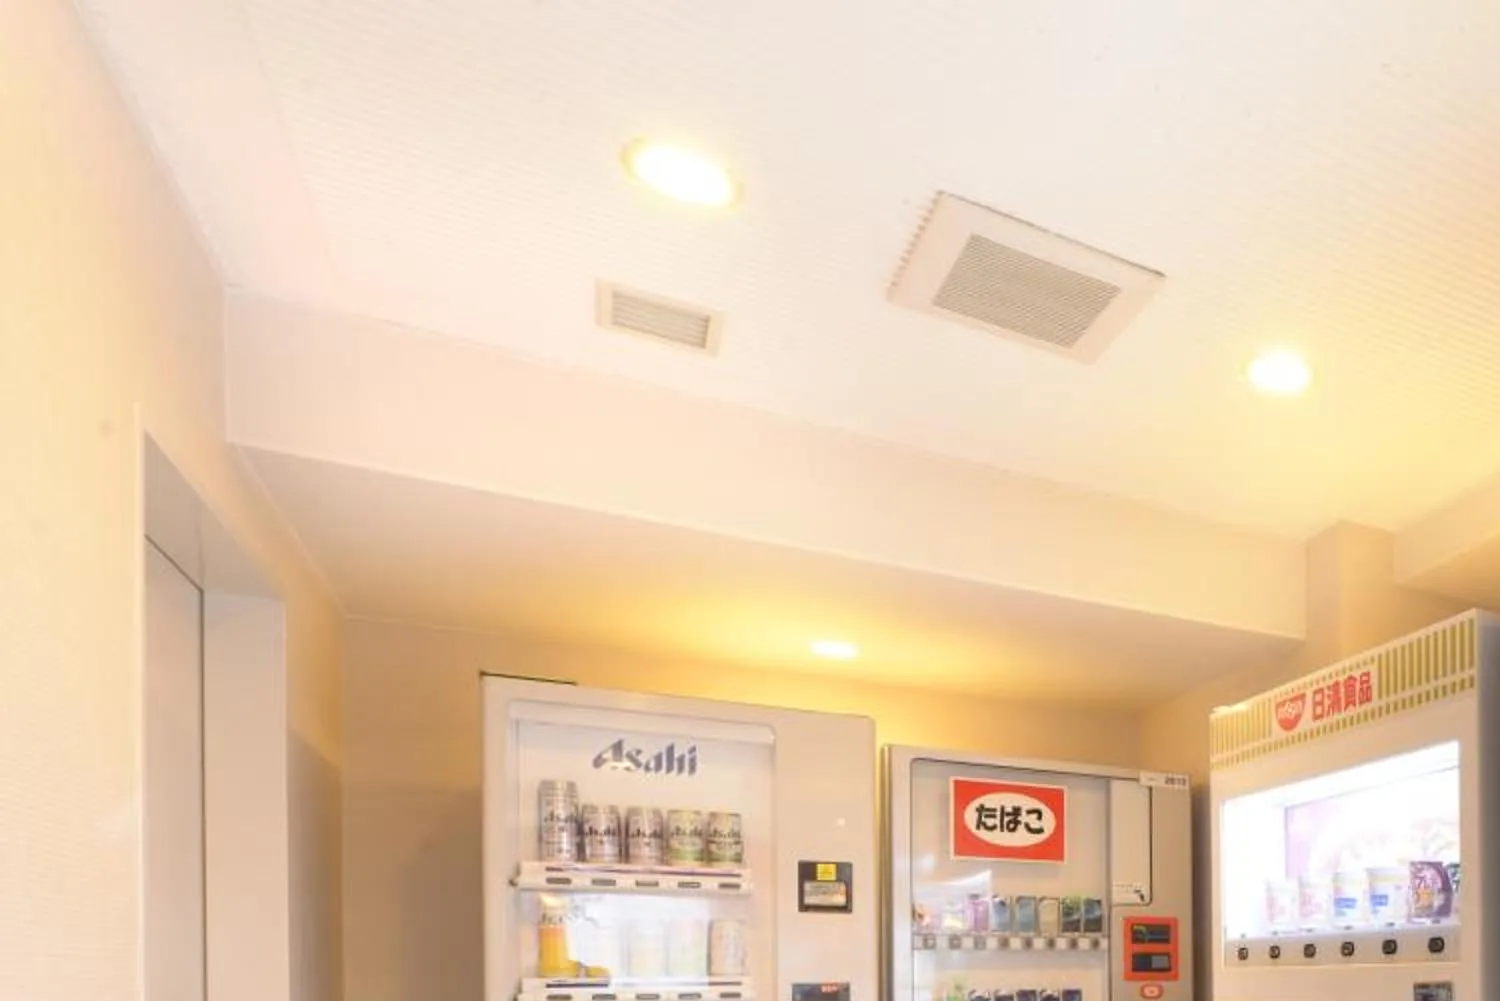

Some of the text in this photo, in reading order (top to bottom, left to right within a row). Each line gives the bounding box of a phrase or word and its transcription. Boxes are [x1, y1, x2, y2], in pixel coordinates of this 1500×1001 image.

[1312, 671, 1373, 721] 日清食品
[592, 738, 698, 777] Asahi
[975, 803, 1045, 835] たばこ
